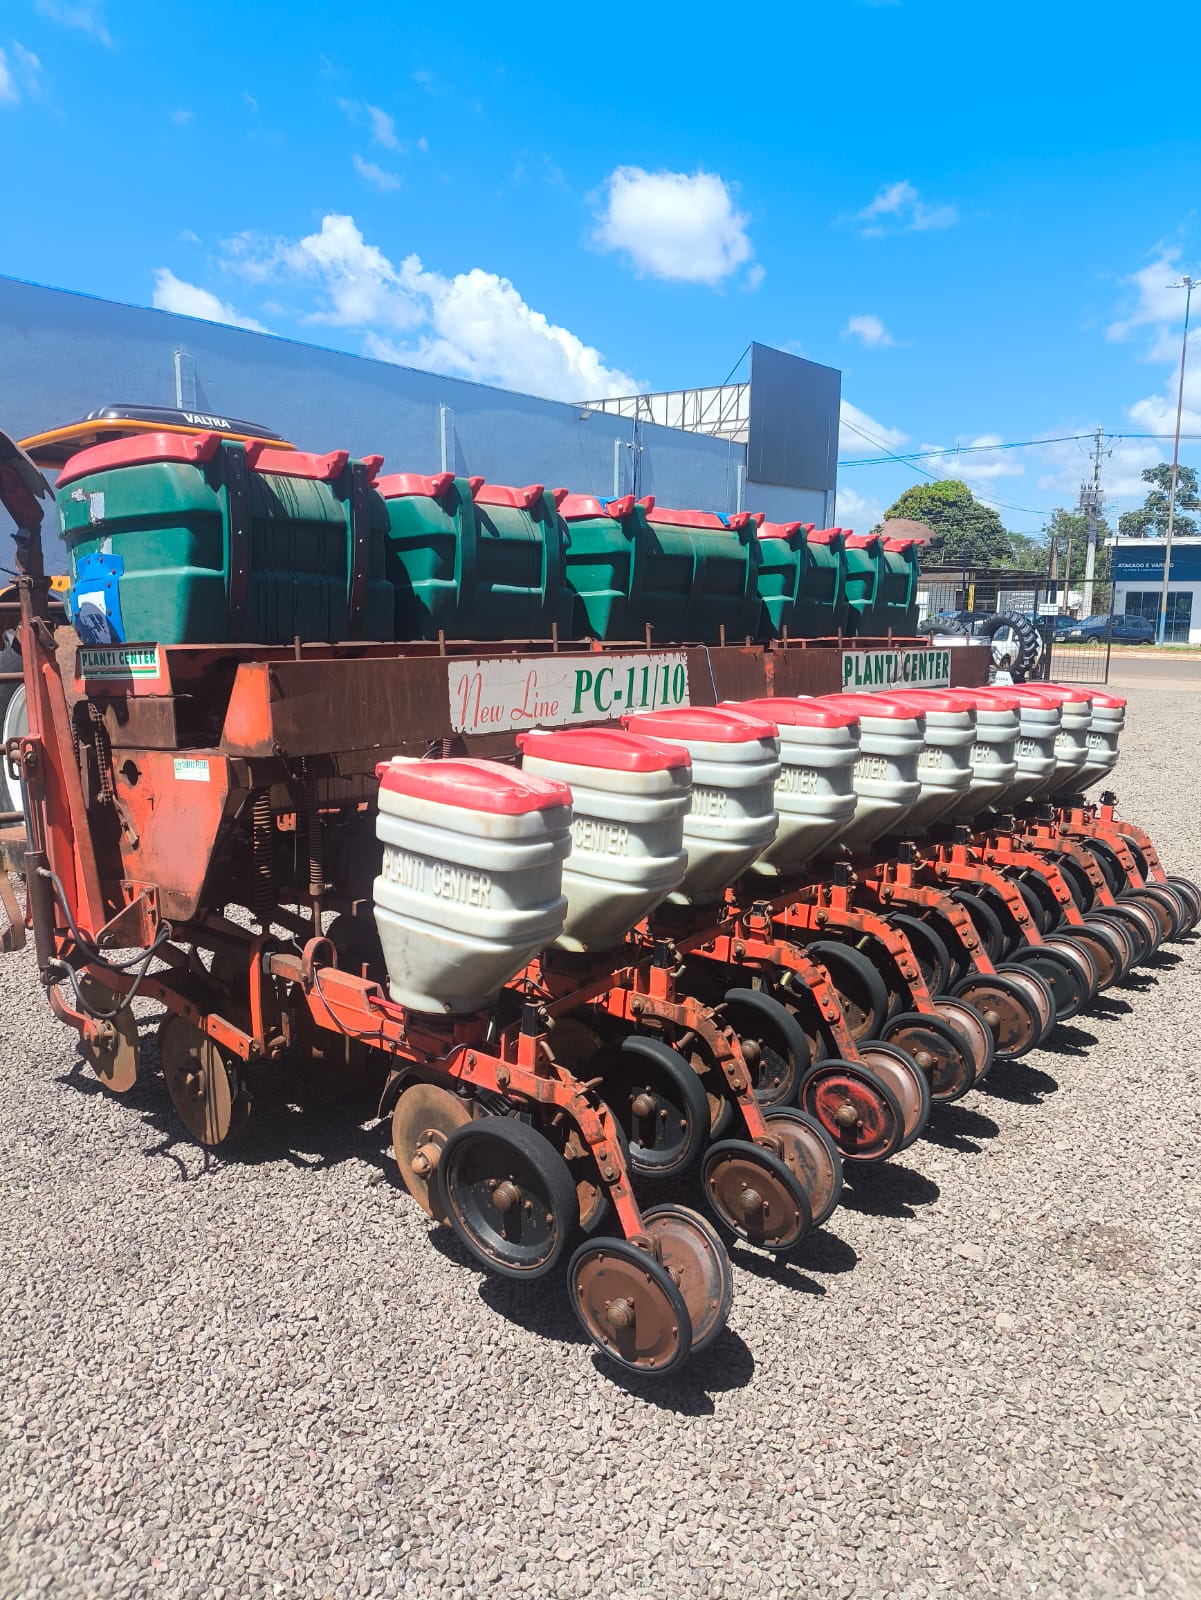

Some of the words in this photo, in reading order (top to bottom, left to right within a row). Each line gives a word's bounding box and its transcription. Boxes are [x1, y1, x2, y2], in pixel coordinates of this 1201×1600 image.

[182, 412, 231, 429] VALTRA
[82, 652, 116, 667] PLANTI
[119, 650, 156, 665] CENTER
[844, 654, 899, 687] PLANTI
[902, 651, 949, 682] CENTER
[457, 672, 505, 728] New
[510, 669, 559, 721] Line
[572, 663, 686, 715] PC-11/10
[691, 787, 728, 818] NTER
[574, 818, 629, 857] CENTER
[382, 846, 426, 892] PLANTI
[432, 862, 492, 910] CENTER
